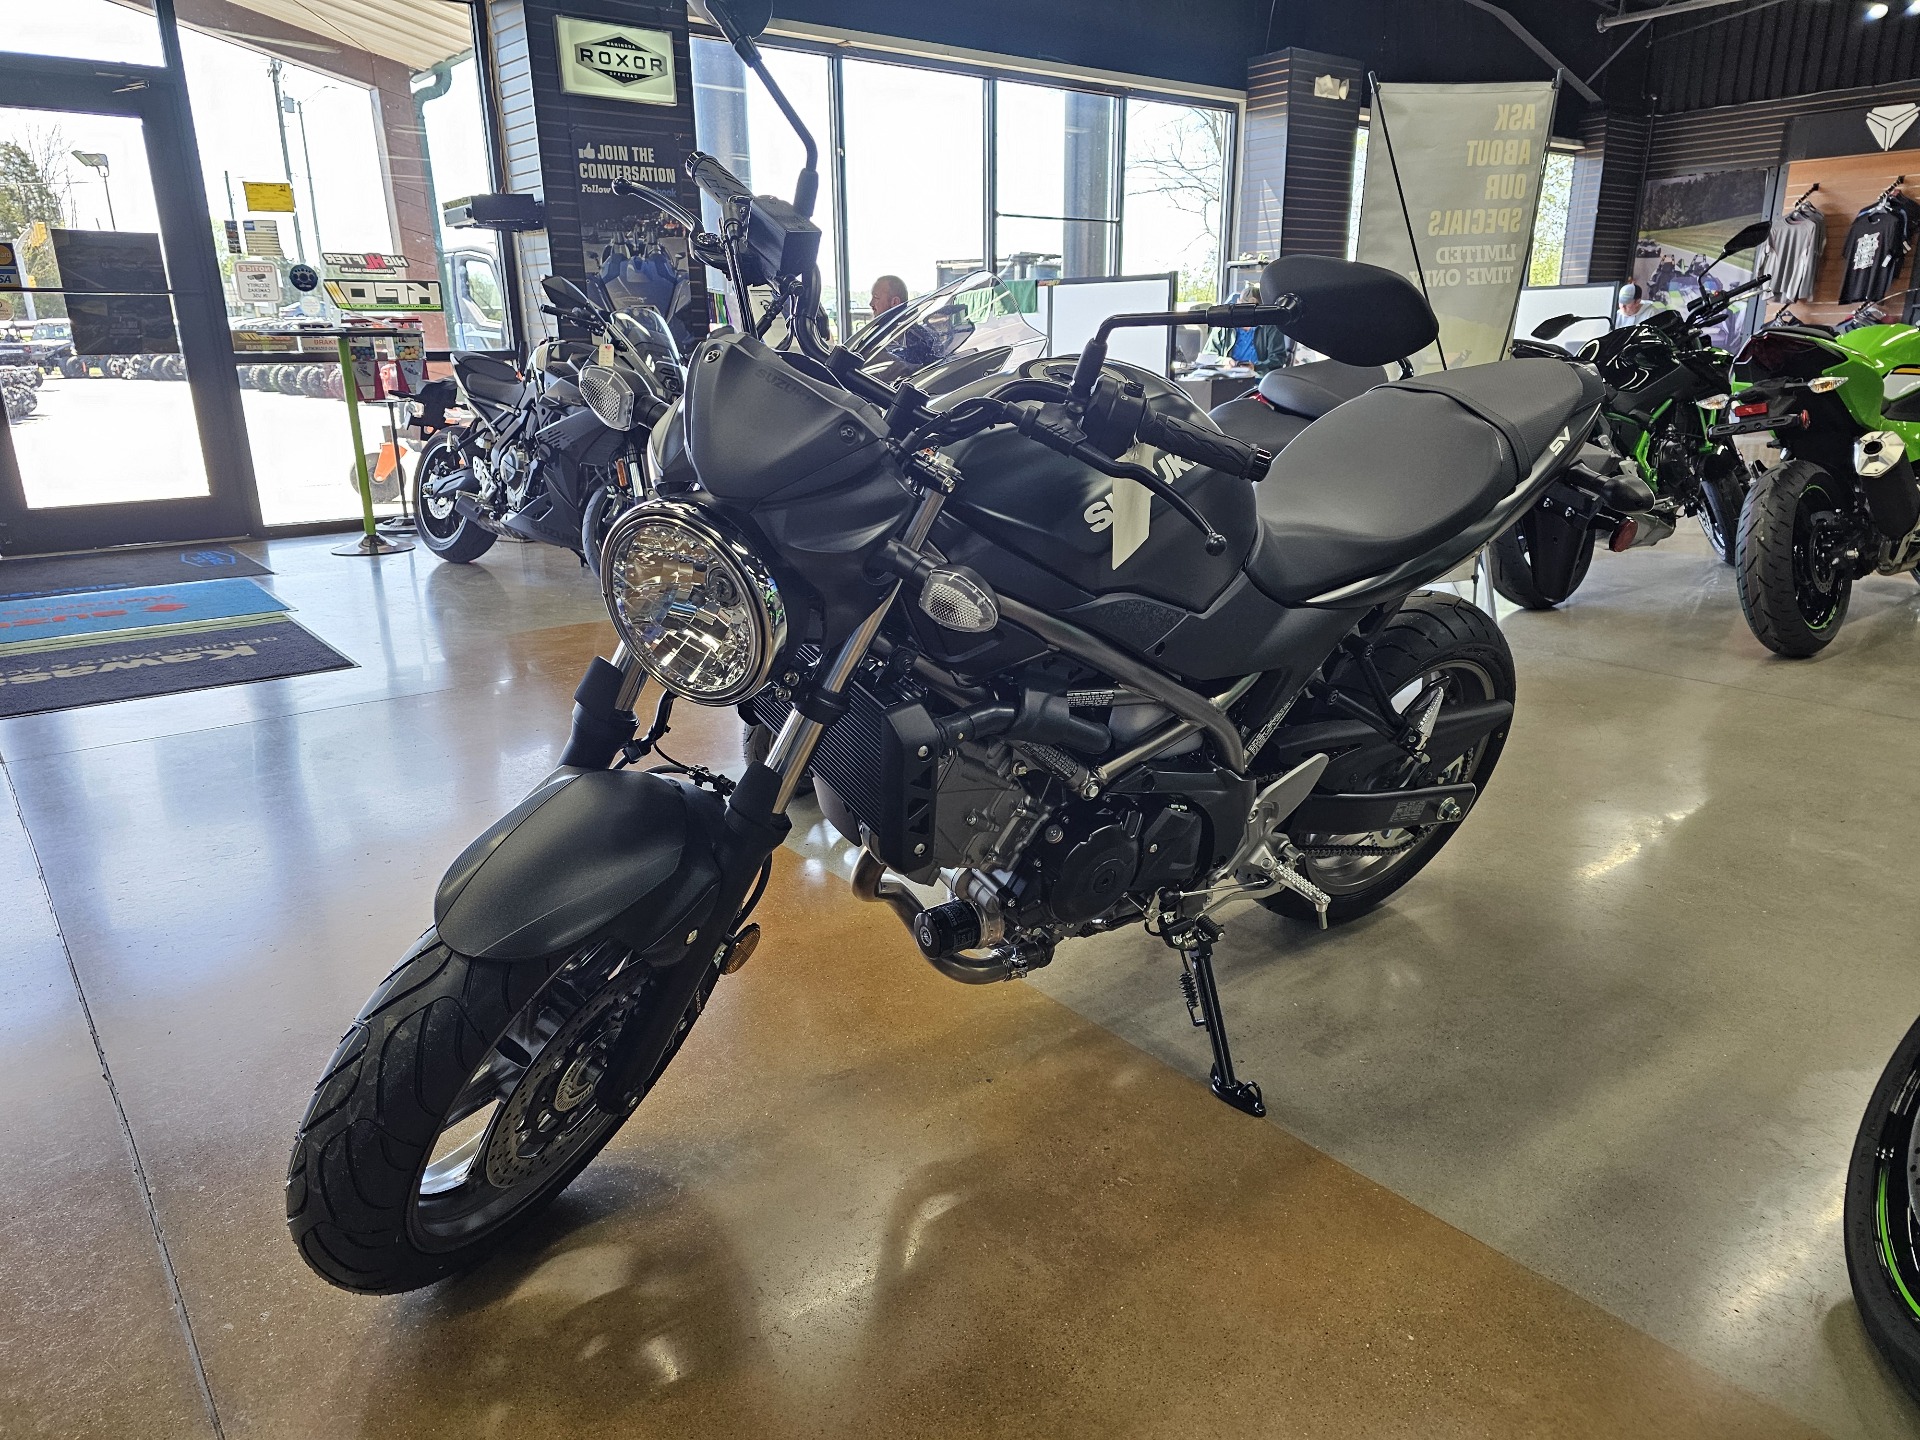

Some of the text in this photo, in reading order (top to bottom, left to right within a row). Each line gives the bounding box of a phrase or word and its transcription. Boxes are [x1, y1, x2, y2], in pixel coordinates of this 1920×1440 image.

[579, 48, 663, 72] ROXOR
[597, 144, 655, 163] JOIN THE
[579, 162, 676, 184] CONVERSATION
[581, 183, 611, 194] Follow
[1548, 425, 1571, 457] SV
[78, 650, 163, 666] PARTS
